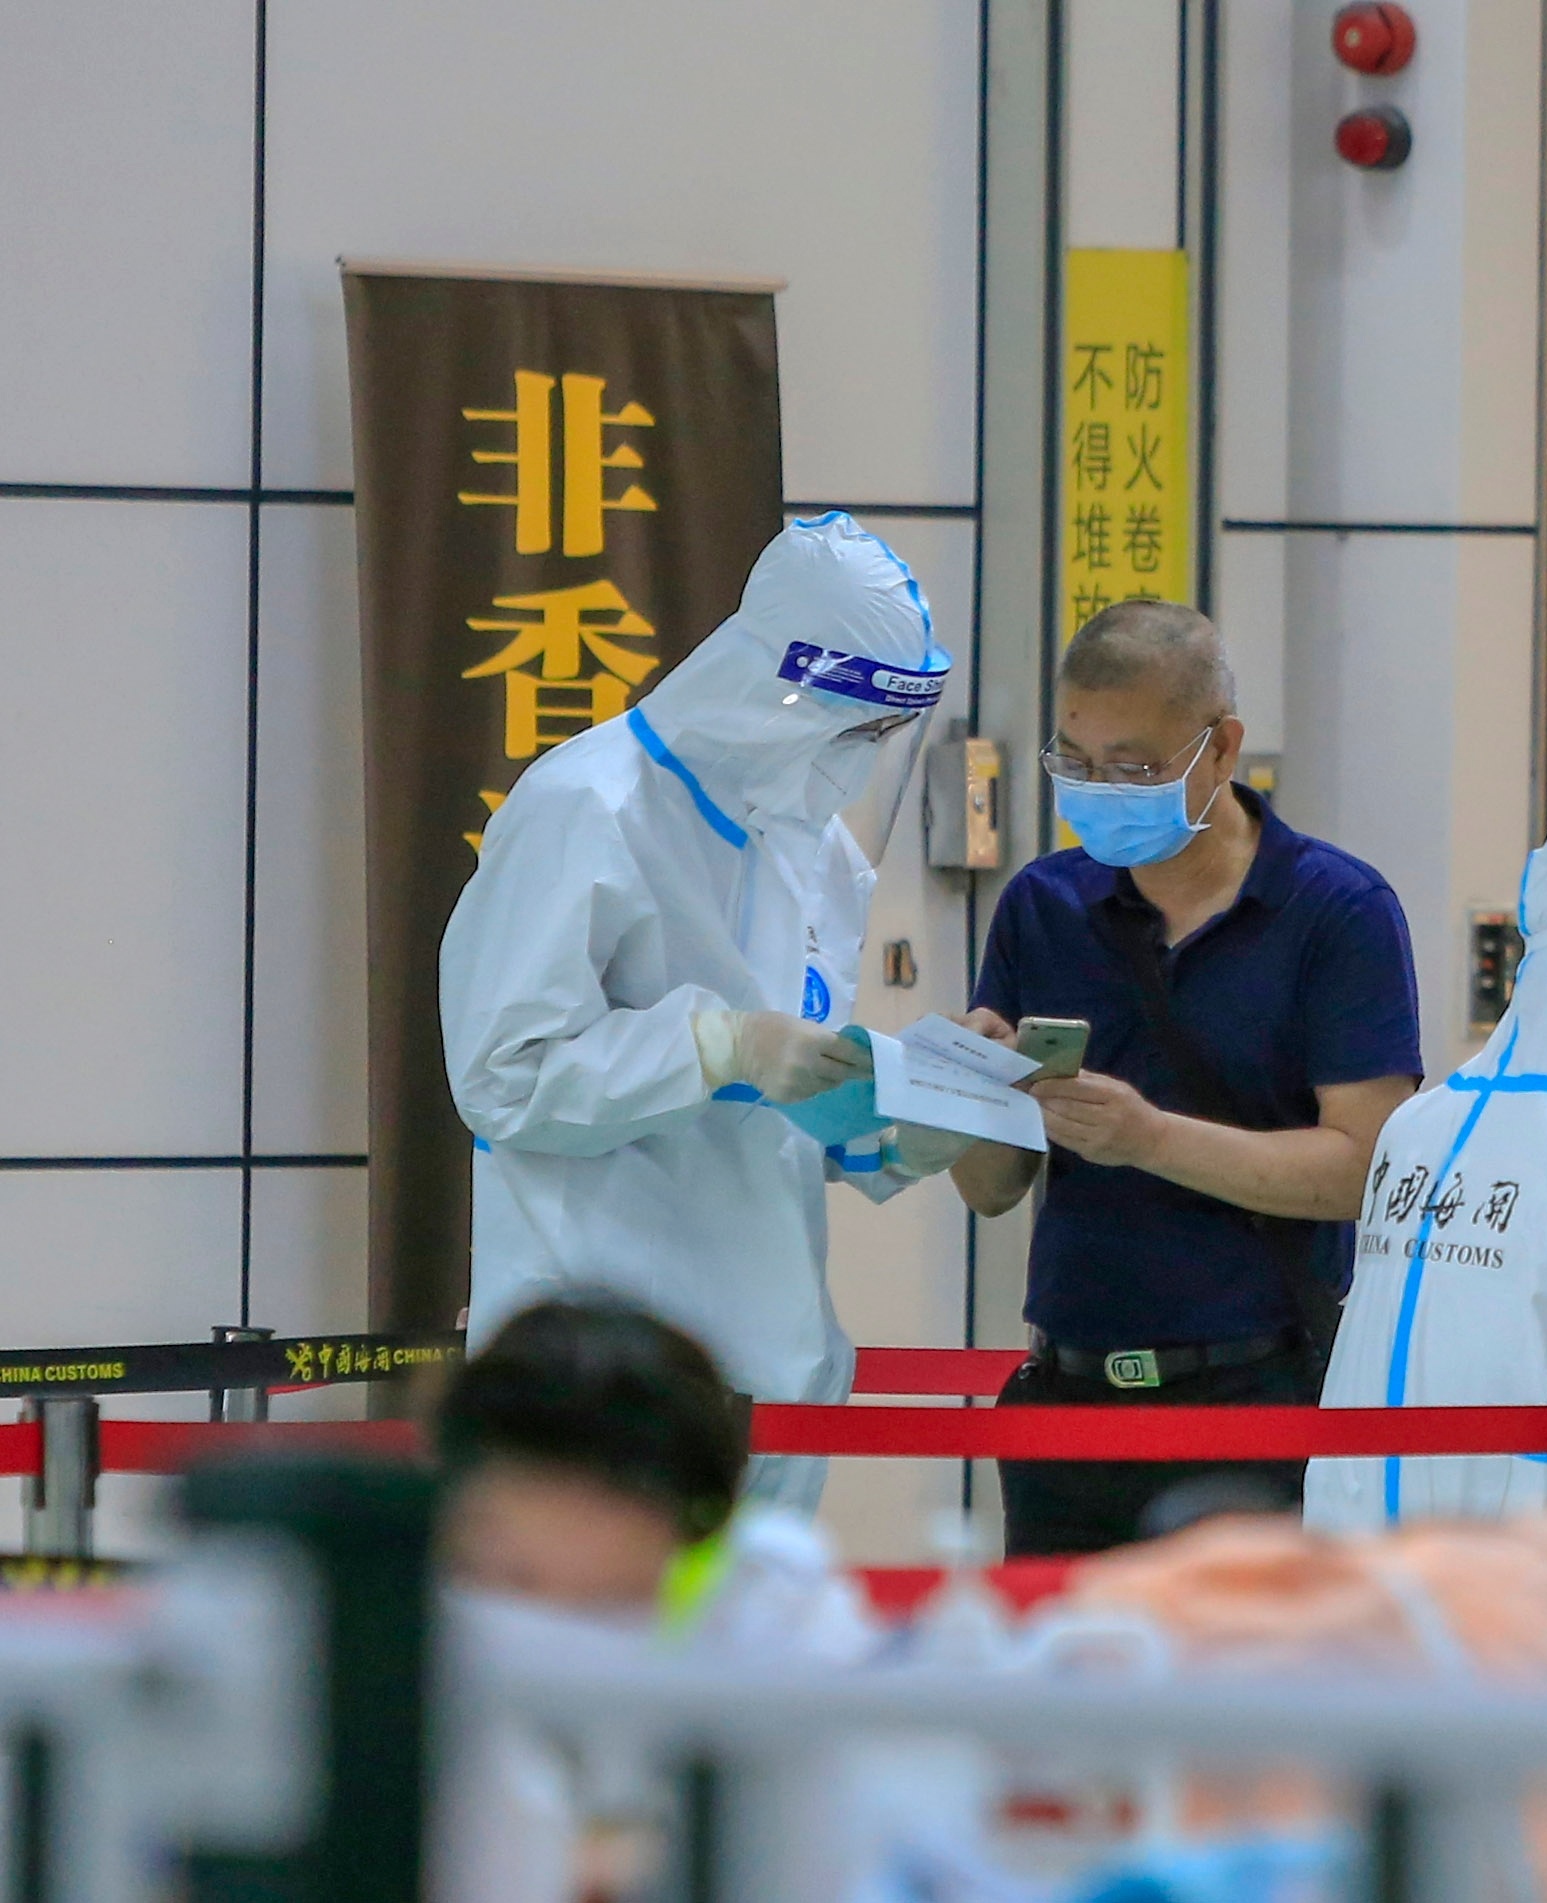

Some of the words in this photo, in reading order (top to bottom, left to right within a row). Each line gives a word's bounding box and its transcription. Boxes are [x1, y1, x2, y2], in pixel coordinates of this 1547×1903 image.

[1123, 341, 1164, 602] 防火卷
[457, 369, 660, 858] 非香
[887, 675, 921, 692] Face
[1404, 1239, 1504, 1269] CUSTOMS
[393, 1348, 442, 1365] CHINA
[0, 1367, 42, 1382] HINA
[45, 1363, 125, 1381] CUSTOMS
